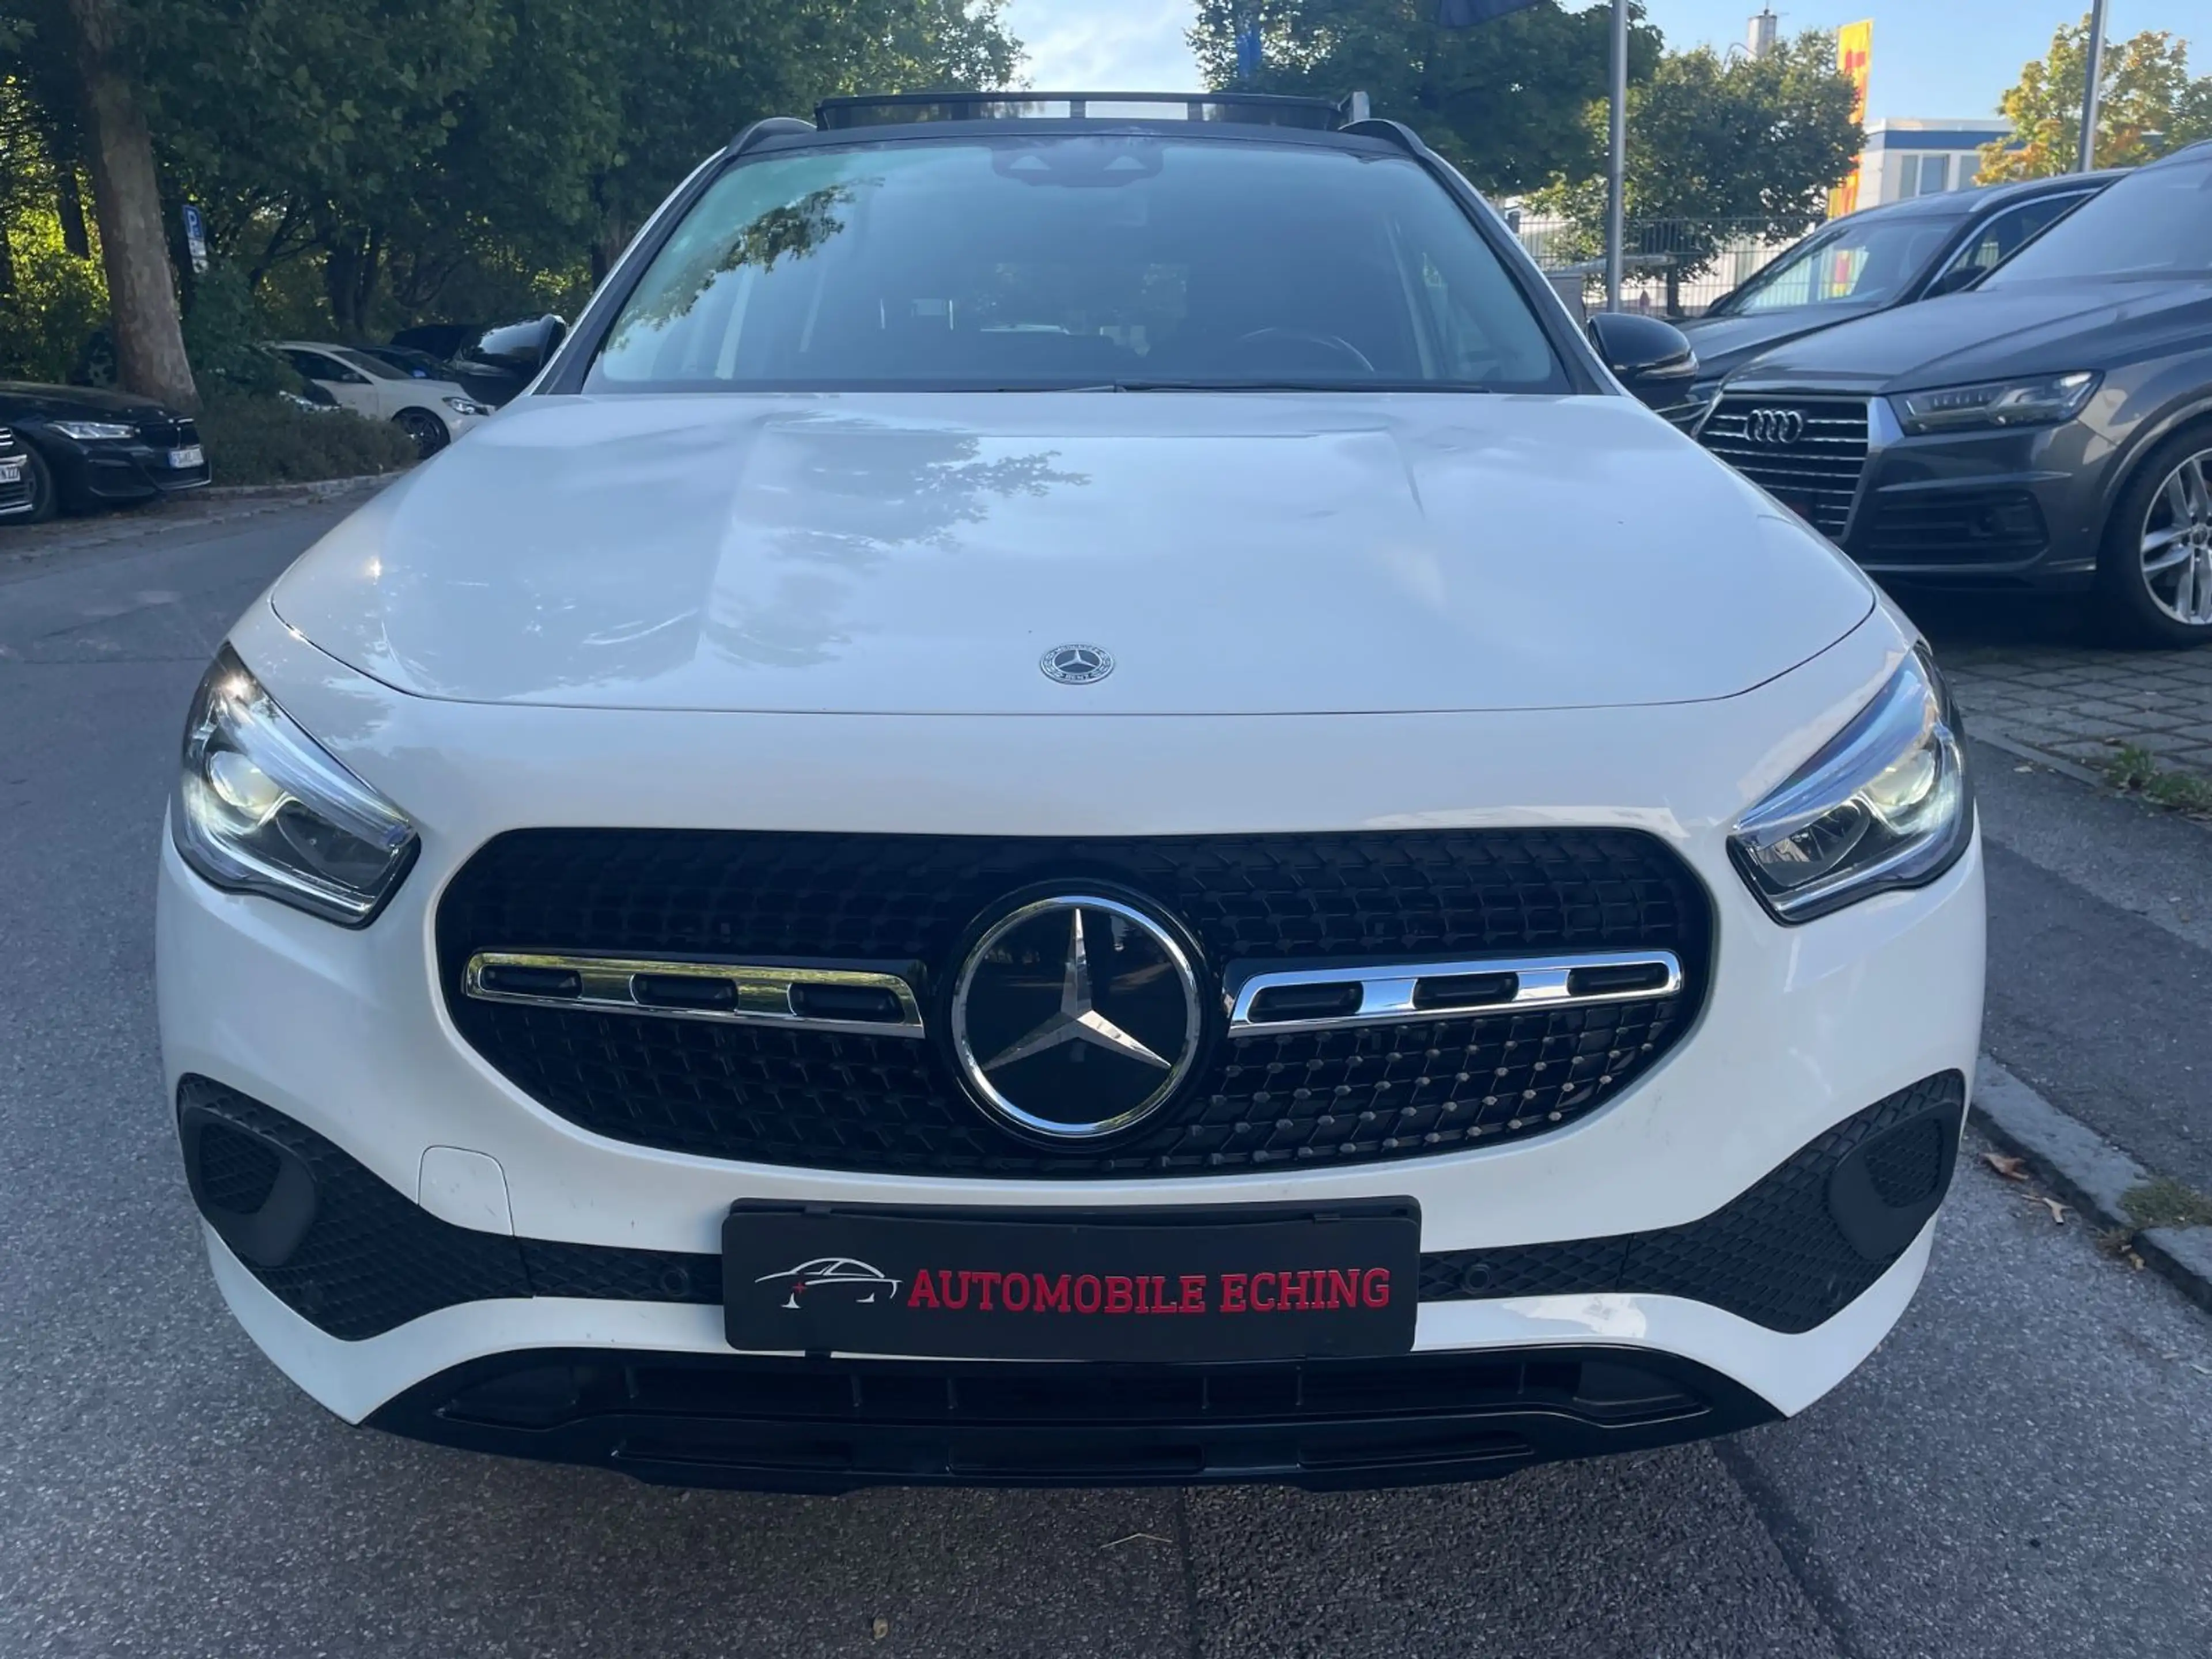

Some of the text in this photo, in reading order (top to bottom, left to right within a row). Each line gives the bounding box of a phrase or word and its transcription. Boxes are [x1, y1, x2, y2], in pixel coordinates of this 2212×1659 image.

[187, 210, 197, 237] P
[908, 1268, 1391, 1313] AUTOMOBILE ECHING
